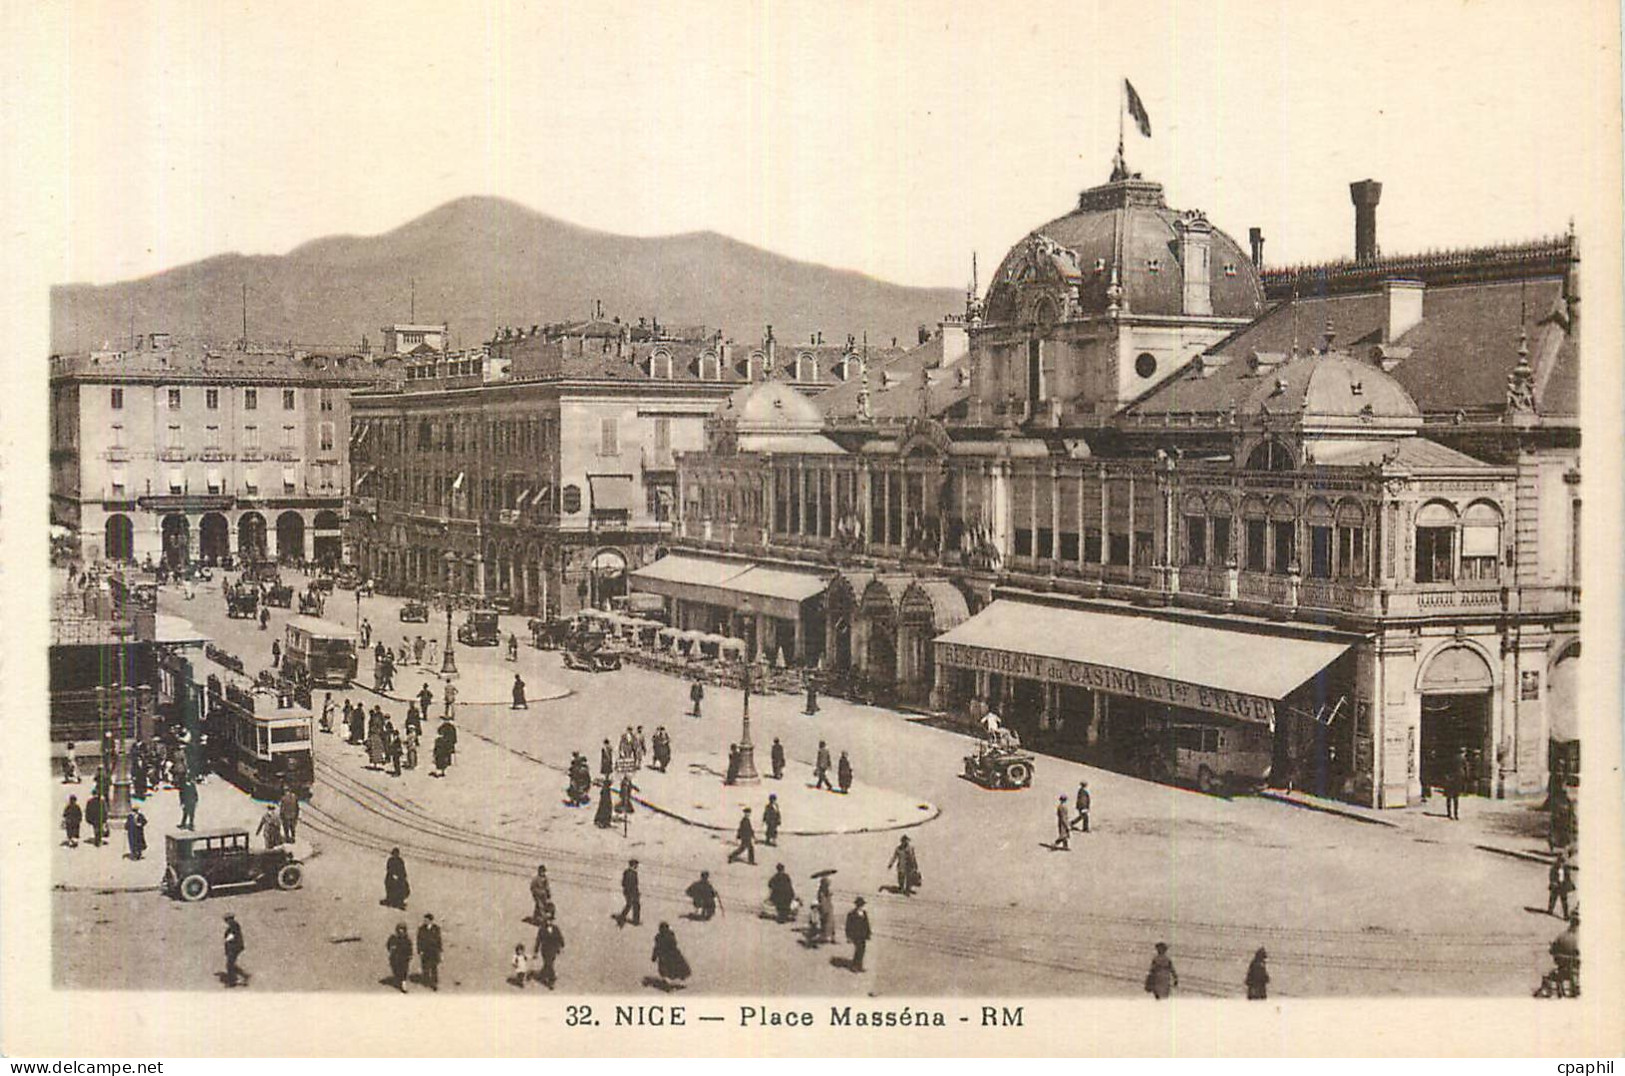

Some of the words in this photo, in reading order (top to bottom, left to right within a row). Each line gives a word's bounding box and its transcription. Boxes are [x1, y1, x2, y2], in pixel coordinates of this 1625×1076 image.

[945, 644, 1043, 676] RESTAURANT
[1048, 663, 1064, 680] du
[1068, 664, 1136, 693] CASINO
[1145, 682, 1162, 699] au
